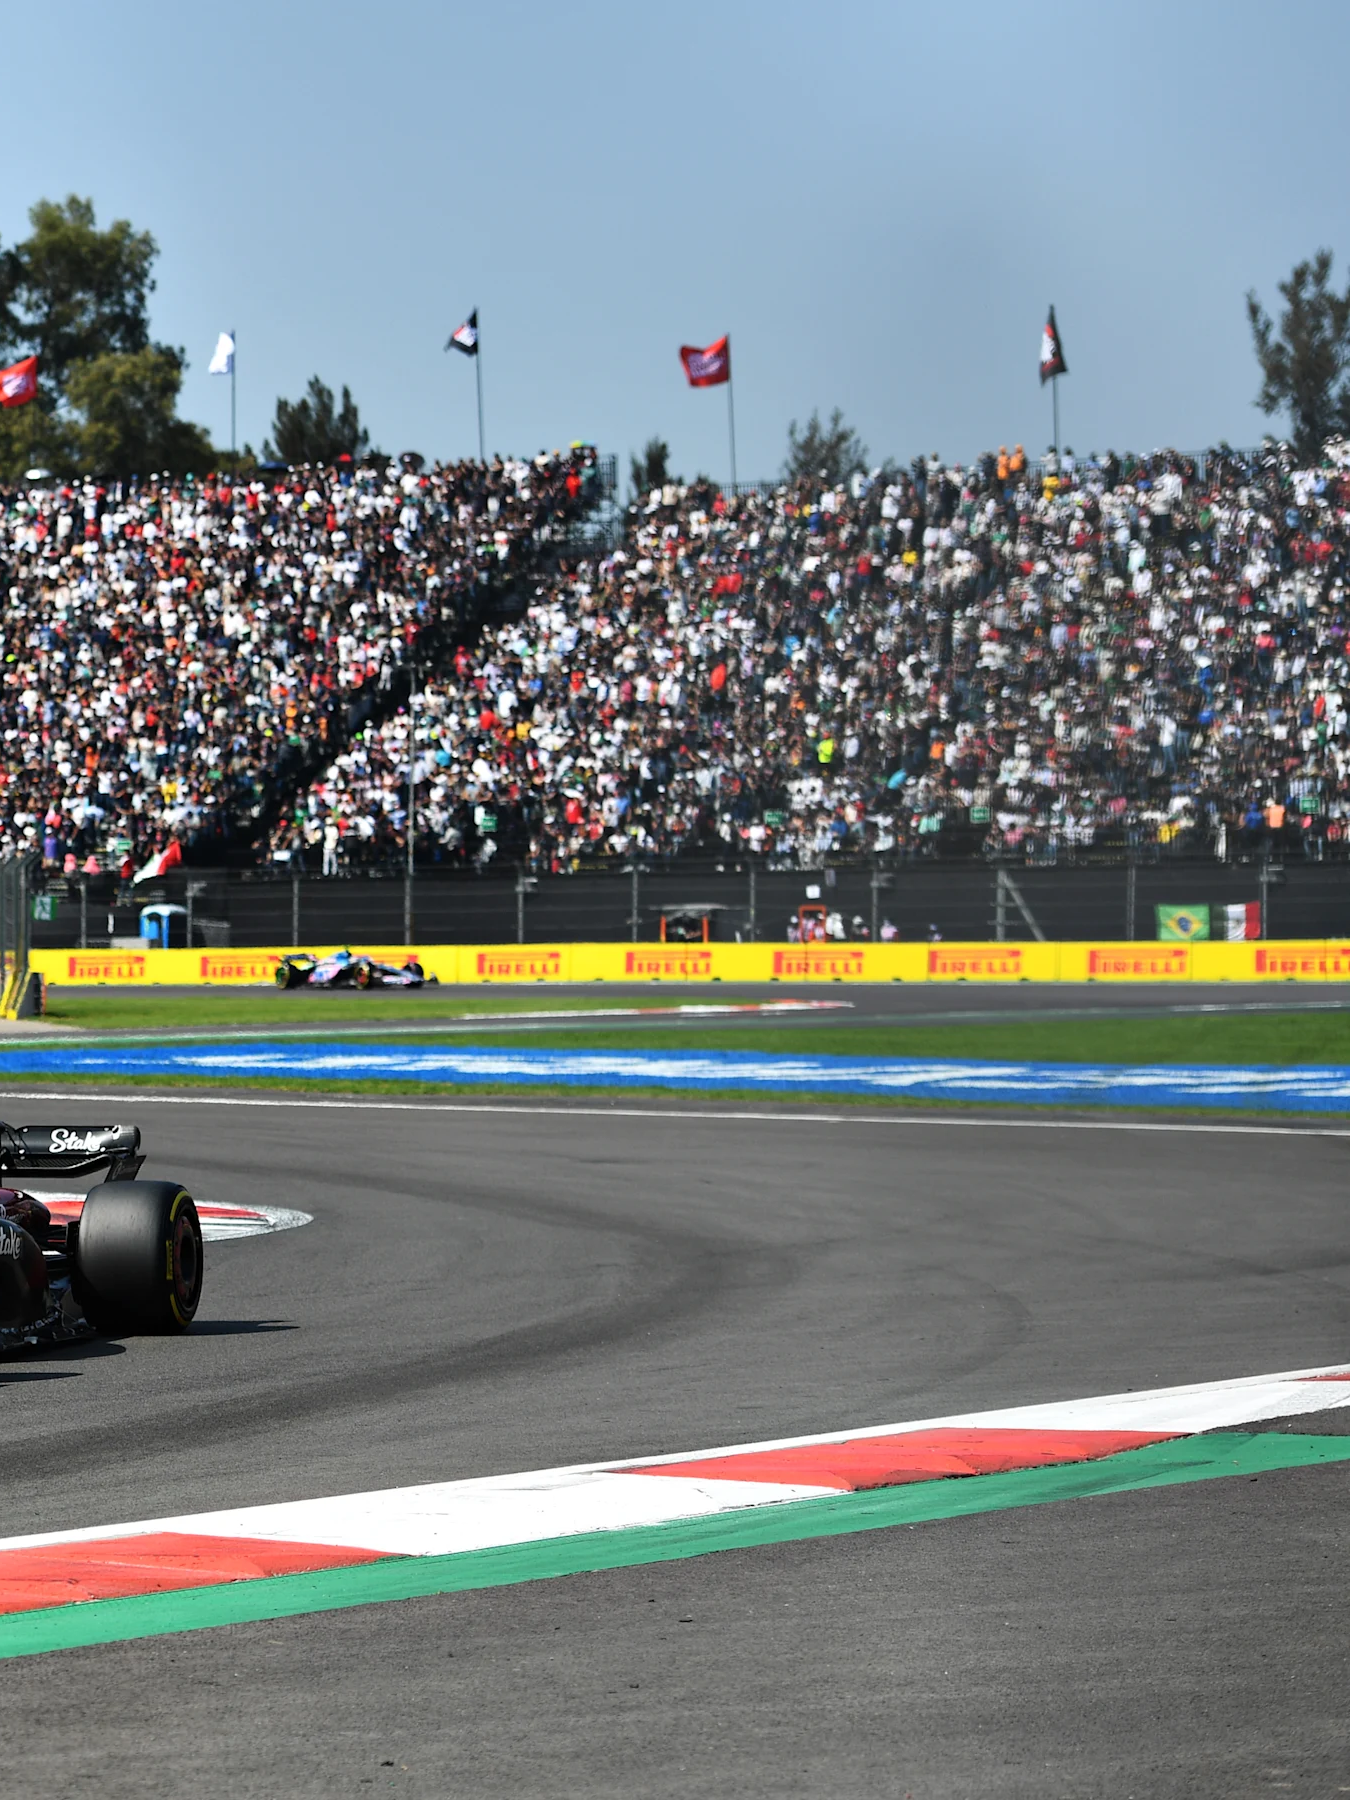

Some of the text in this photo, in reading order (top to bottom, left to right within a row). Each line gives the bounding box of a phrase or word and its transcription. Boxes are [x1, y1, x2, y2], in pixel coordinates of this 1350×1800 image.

[69, 955, 145, 978] PIRELLI
[477, 952, 560, 976] PIRELLI
[626, 951, 712, 975] PIRELLI
[773, 951, 864, 975] PIRELLI
[928, 950, 1022, 975] PIRELLI
[1088, 949, 1187, 975] PIRELLI
[1255, 948, 1350, 975] PIRELL
[49, 1129, 102, 1153] Stake
